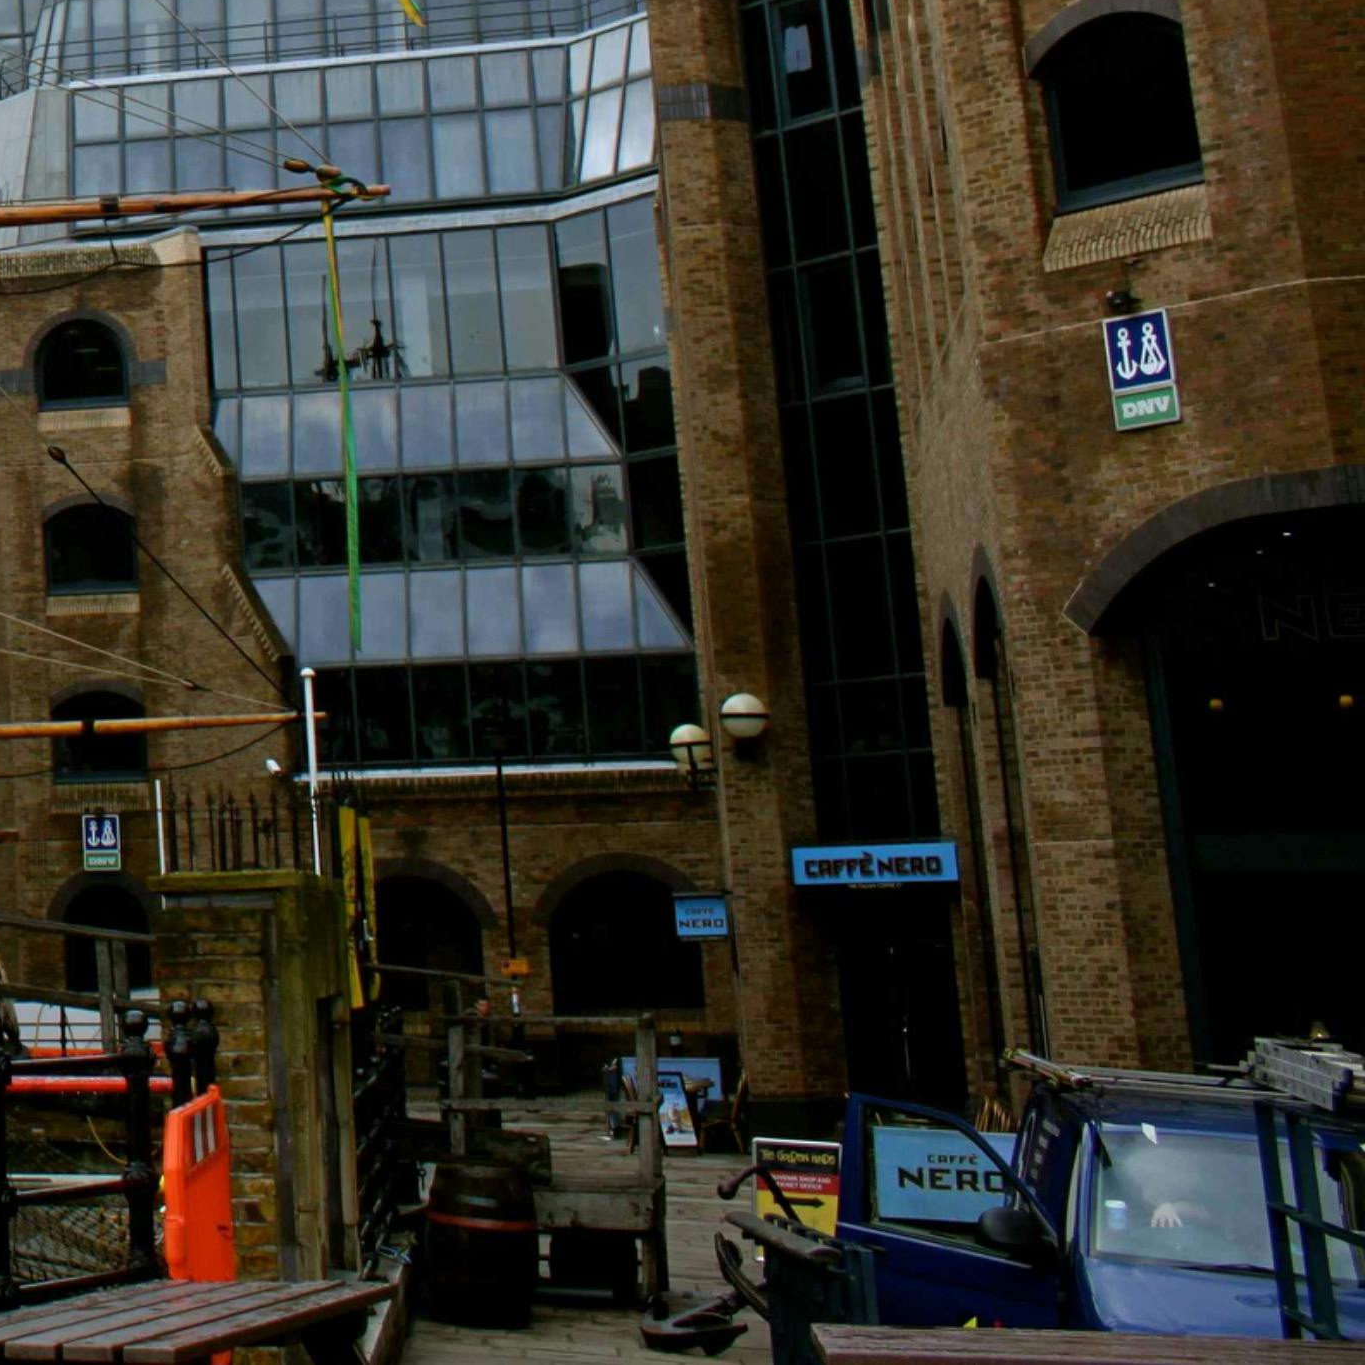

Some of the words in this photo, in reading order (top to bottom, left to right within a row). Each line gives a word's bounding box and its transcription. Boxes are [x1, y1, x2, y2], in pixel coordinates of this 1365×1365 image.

[1121, 395, 1170, 420] DNV
[877, 856, 943, 877] NERO
[678, 919, 724, 928] NERO
